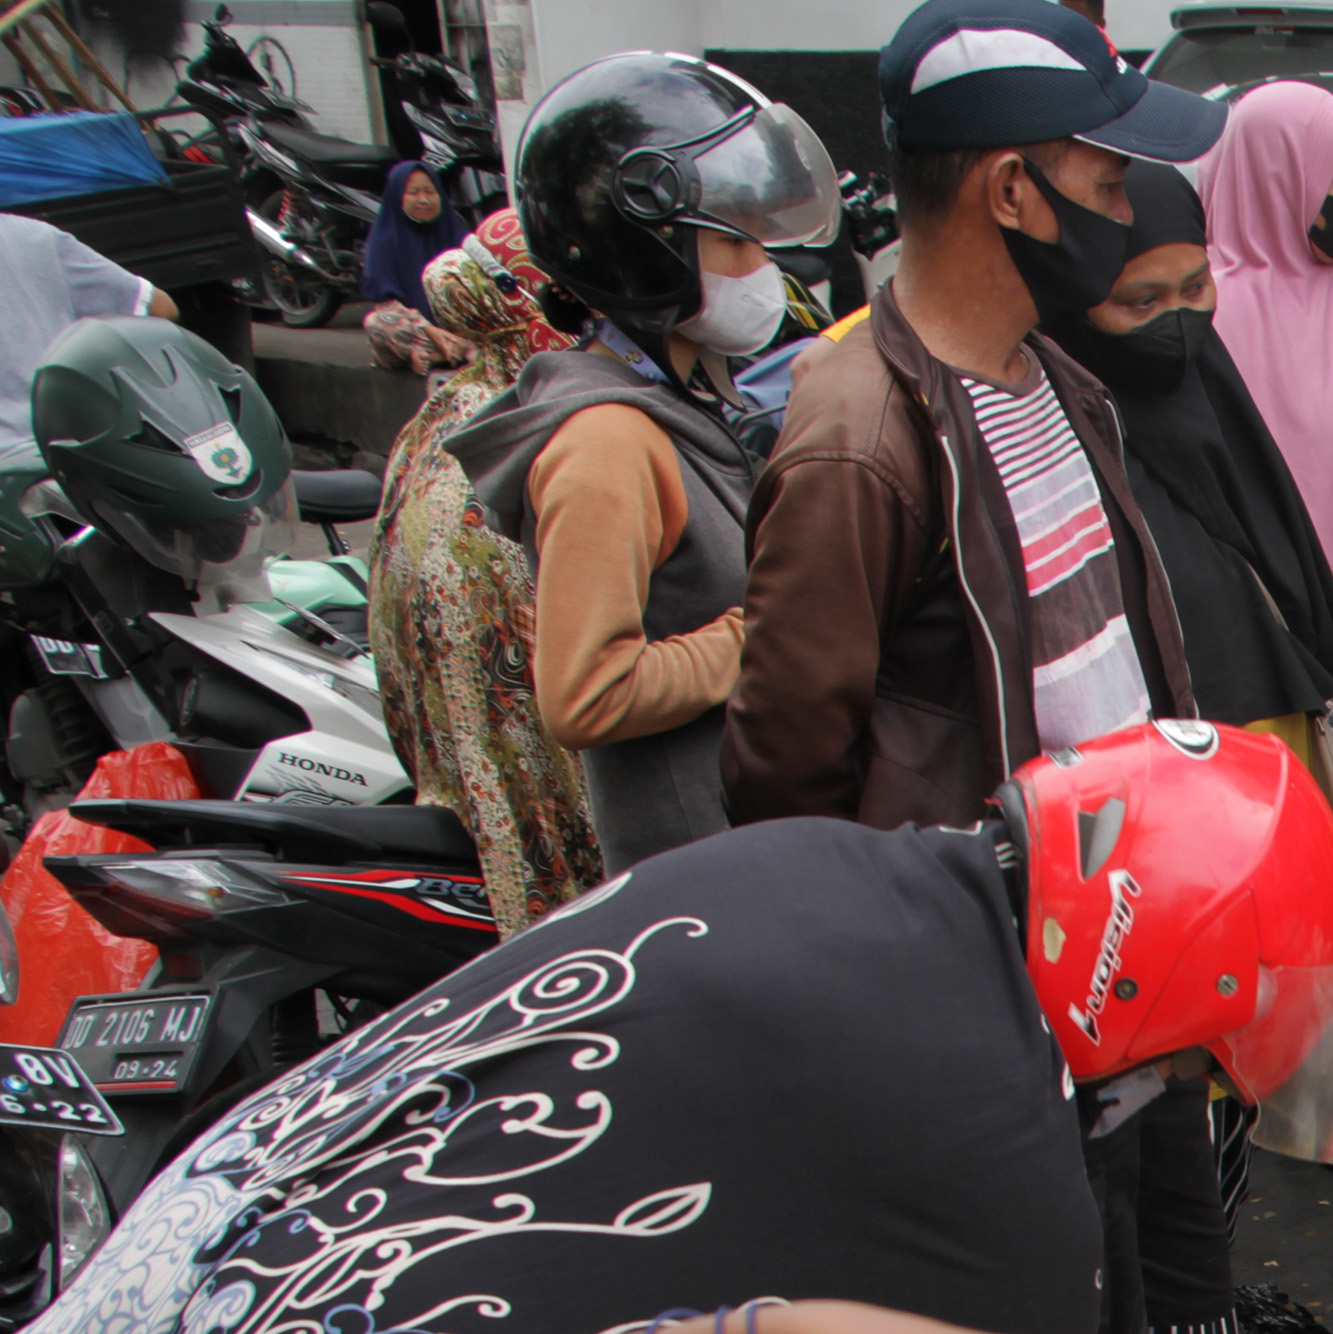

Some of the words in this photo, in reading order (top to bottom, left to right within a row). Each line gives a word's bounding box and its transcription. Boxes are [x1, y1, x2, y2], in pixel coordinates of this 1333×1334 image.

[279, 752, 368, 787] HONDA
[96, 1008, 155, 1047] 2106
[160, 1006, 201, 1042] MJ
